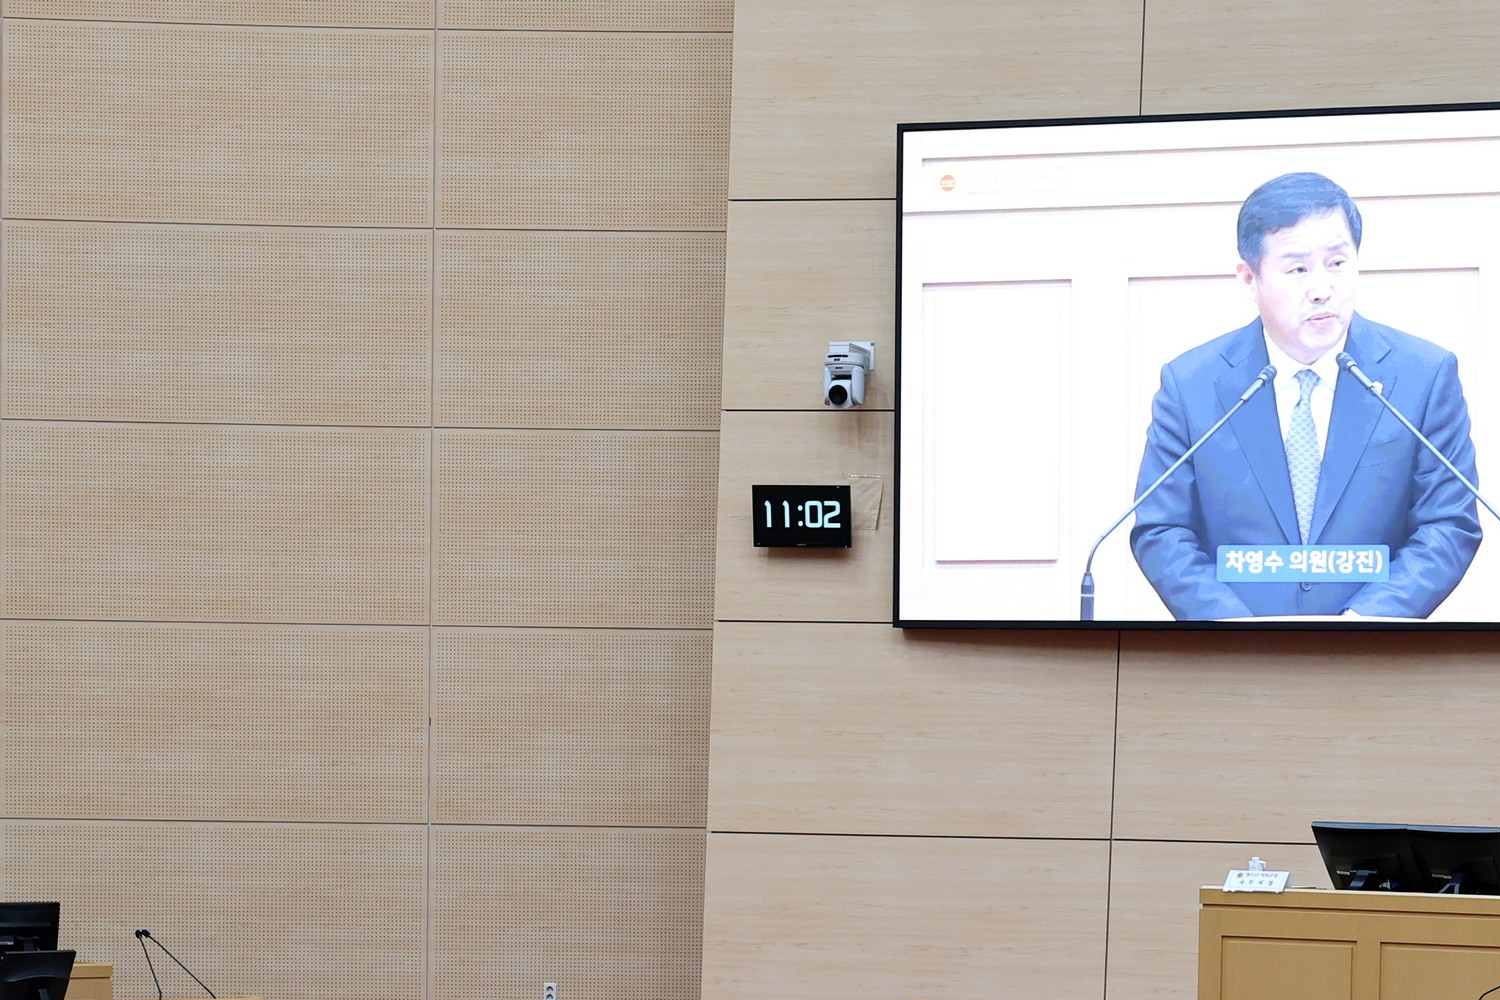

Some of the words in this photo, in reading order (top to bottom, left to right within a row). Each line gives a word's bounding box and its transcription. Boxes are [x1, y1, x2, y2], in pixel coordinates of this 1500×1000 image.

[764, 500, 841, 528] 11:02
[1225, 550, 1283, 574] 차영수
[1289, 550, 1383, 574] 의원(강진)
